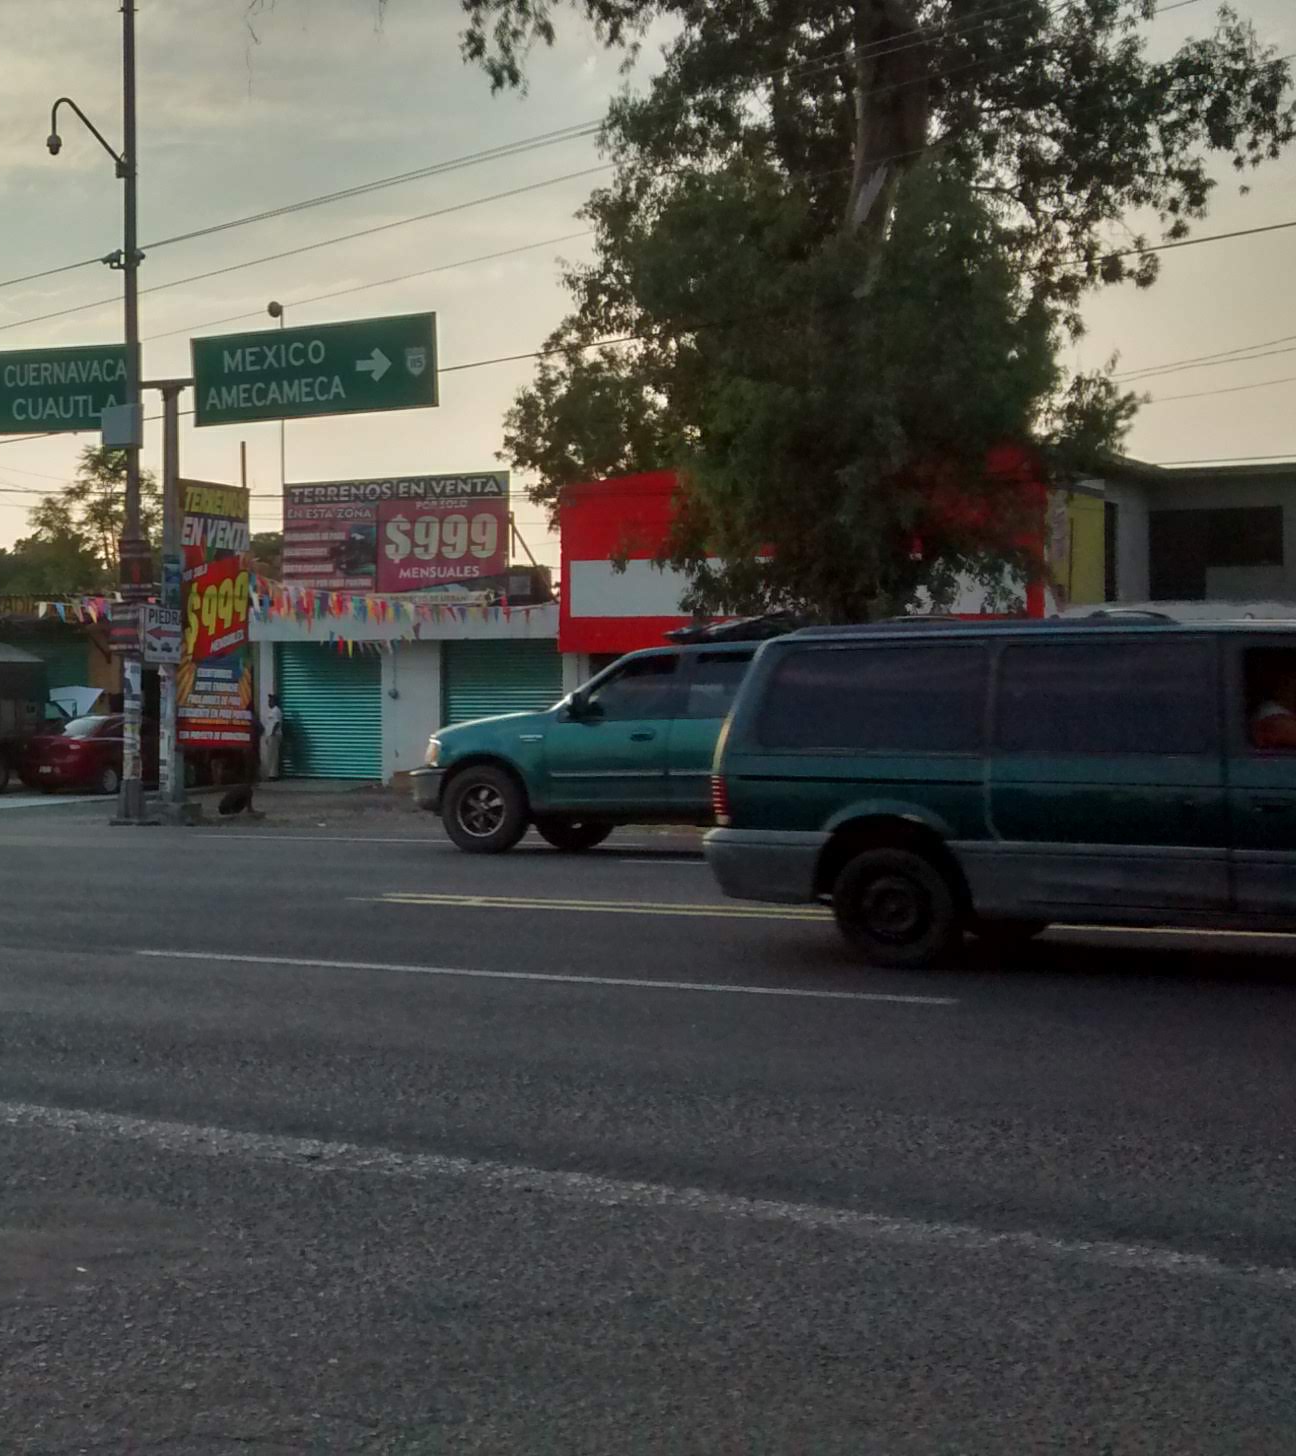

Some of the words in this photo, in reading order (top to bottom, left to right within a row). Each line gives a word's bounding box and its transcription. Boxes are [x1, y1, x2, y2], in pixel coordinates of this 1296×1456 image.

[223, 340, 325, 373] MEXICO
[4, 358, 128, 388] CUERNAVACA
[205, 375, 347, 411] AMECAMECA
[290, 485, 392, 505] TERRENOS
[398, 481, 426, 499] EN
[430, 477, 499, 496] VENTA
[182, 516, 205, 546] EN
[384, 513, 499, 563] $999
[398, 566, 481, 579] MENSUALES
[187, 571, 250, 656] $999
